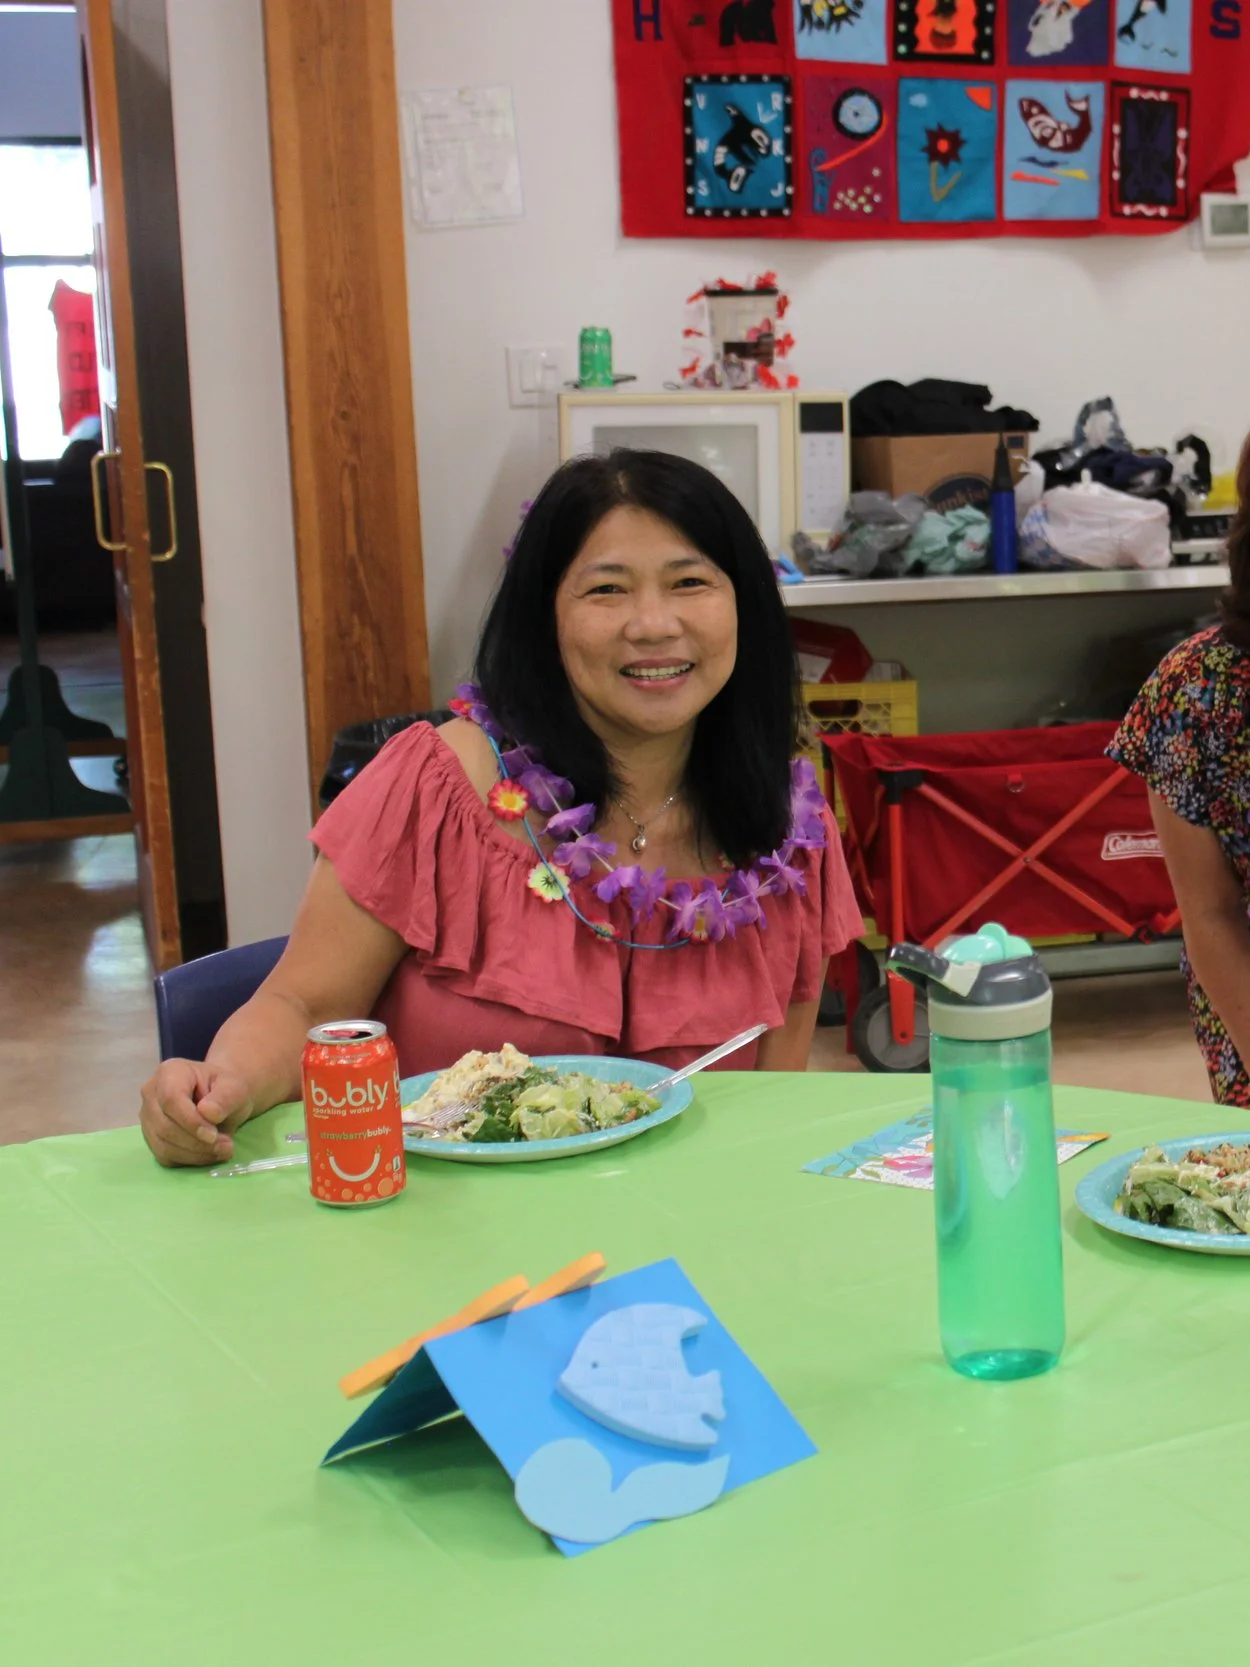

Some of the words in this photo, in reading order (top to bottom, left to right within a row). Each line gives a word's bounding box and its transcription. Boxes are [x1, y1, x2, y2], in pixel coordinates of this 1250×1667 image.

[632, 0, 664, 41] H
[1209, 0, 1241, 39] S
[310, 1078, 388, 1110] bubly
